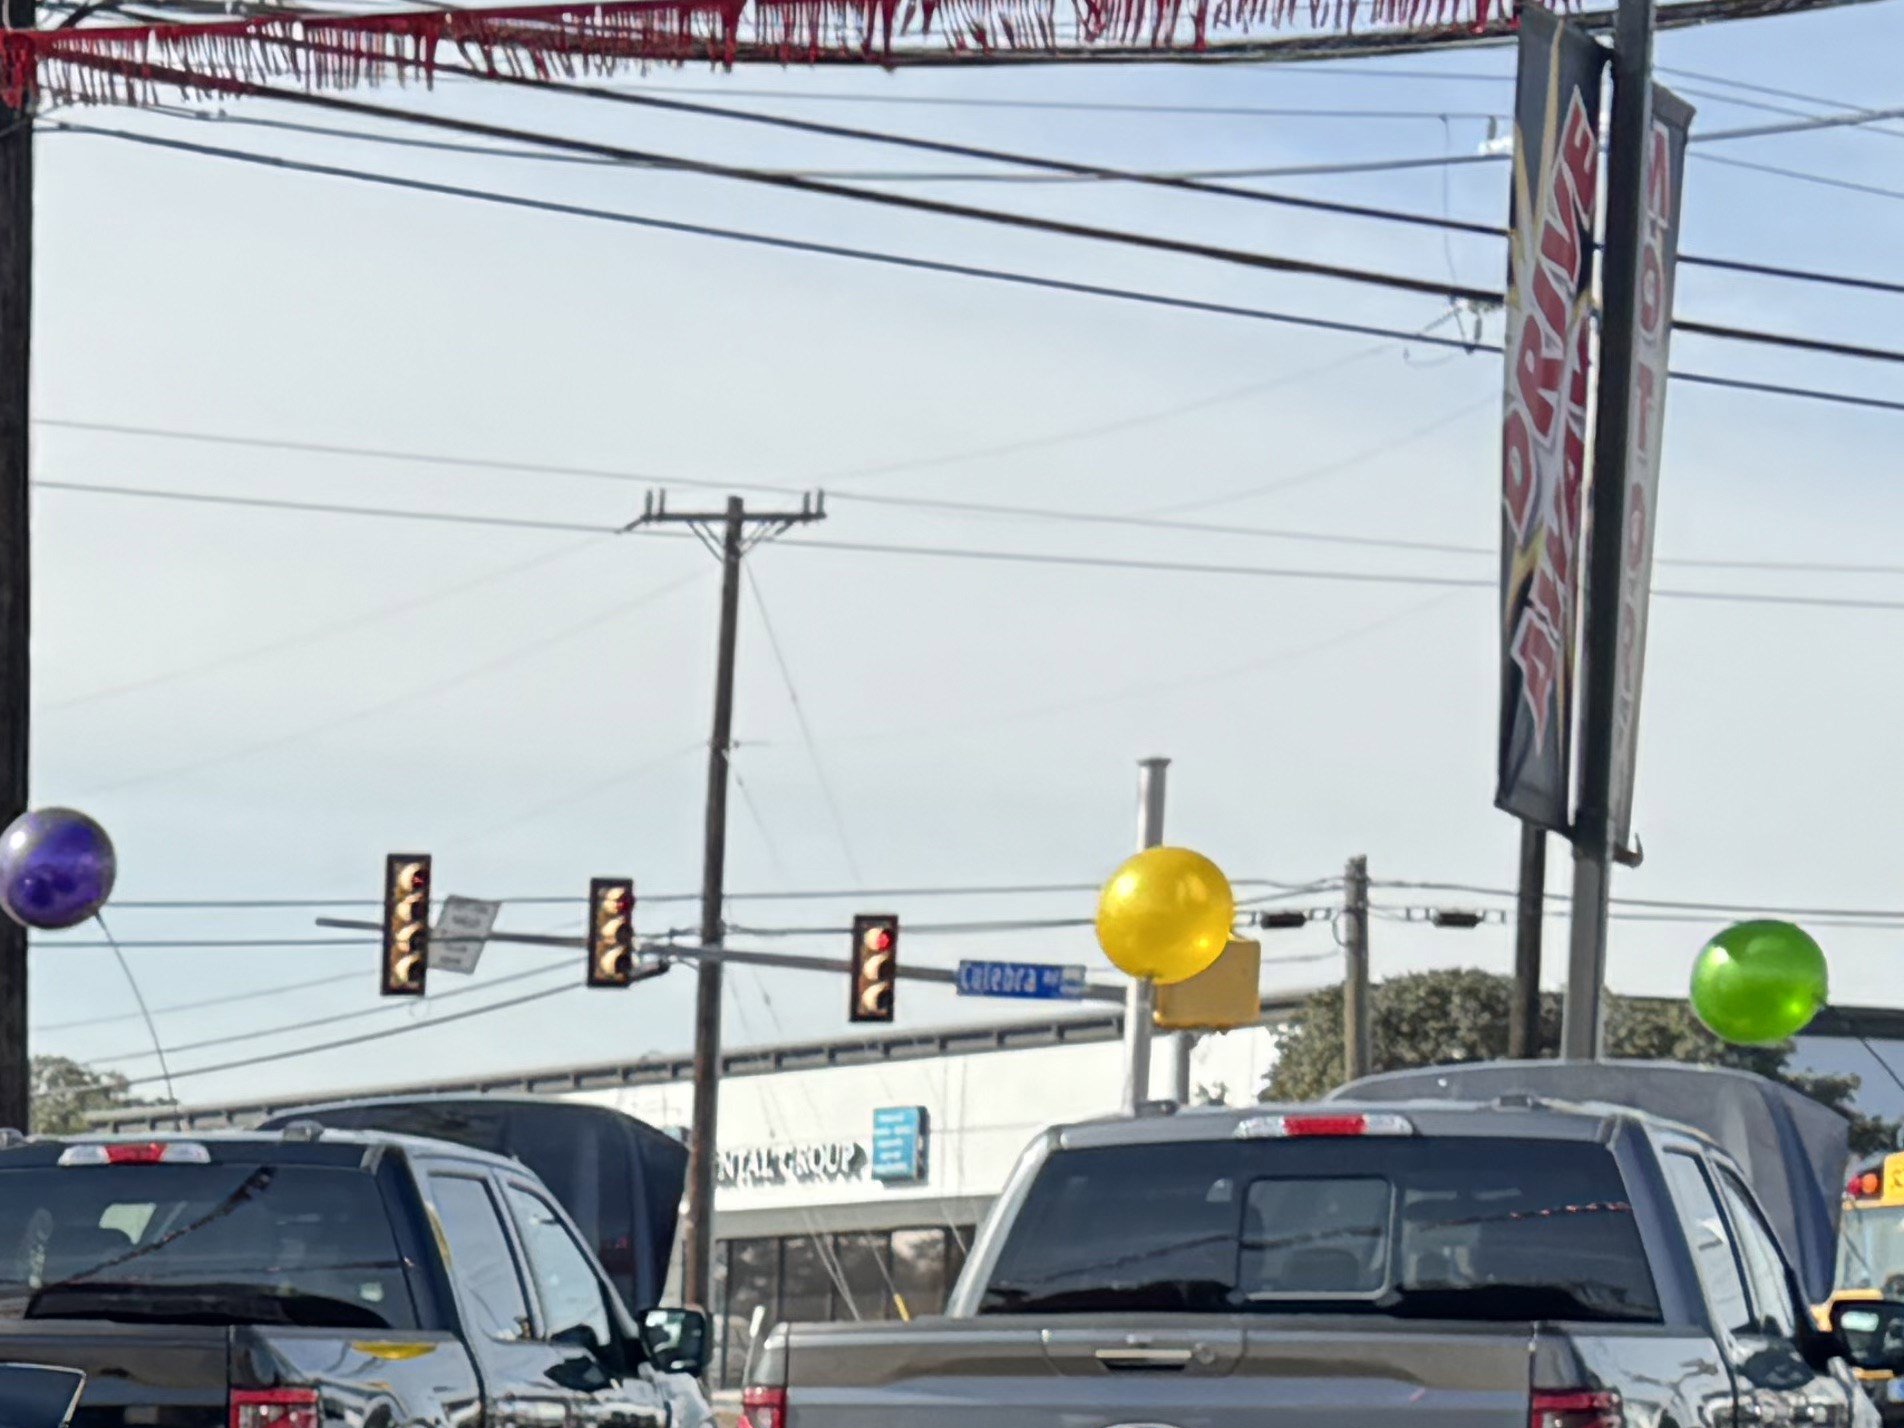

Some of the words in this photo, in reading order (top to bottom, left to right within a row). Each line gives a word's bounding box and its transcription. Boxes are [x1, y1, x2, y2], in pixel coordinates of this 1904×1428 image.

[1502, 86, 1596, 537] DRIVE
[960, 963, 1037, 993] Culebra
[716, 1148, 775, 1180] NTAL
[778, 1142, 856, 1179] GROUP
